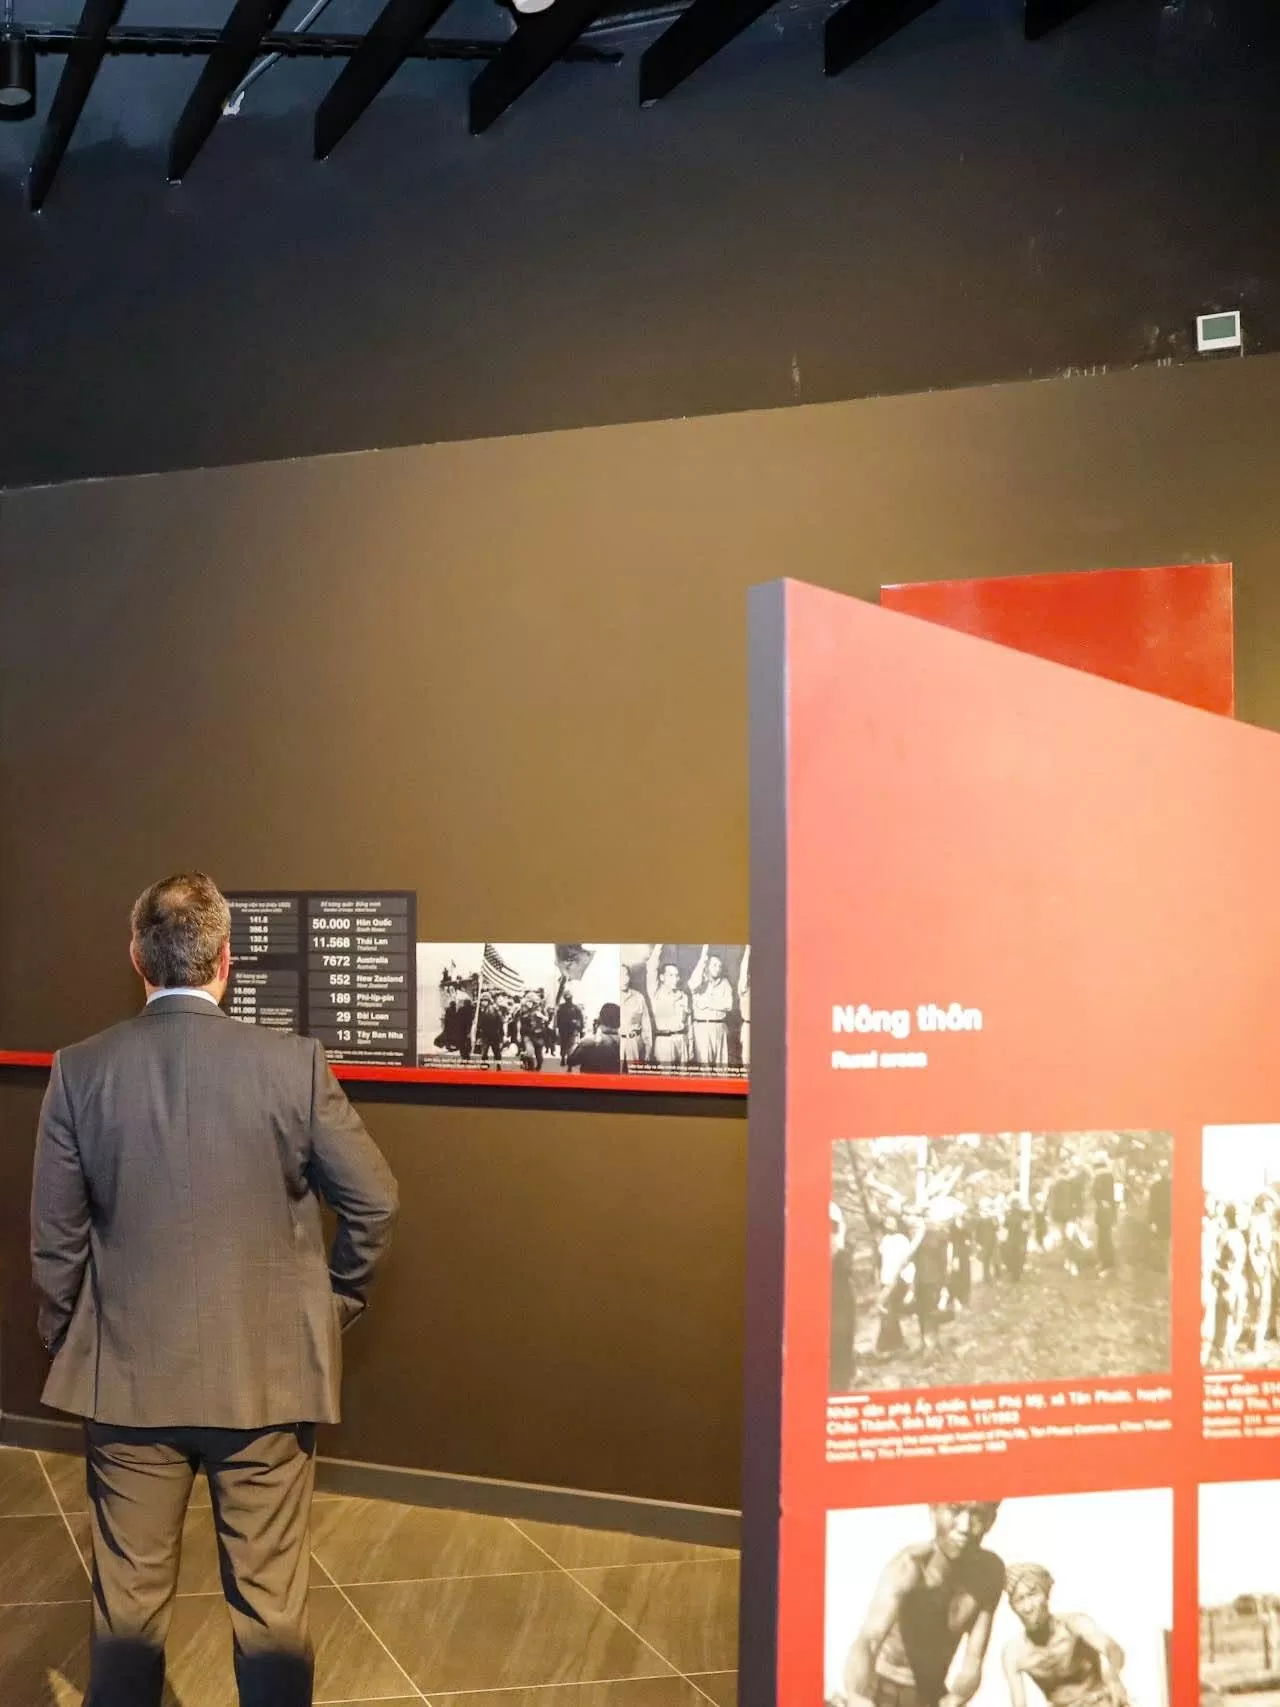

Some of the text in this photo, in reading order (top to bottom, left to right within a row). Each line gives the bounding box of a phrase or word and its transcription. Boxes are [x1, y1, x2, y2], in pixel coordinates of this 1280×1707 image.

[312, 918, 350, 929] 50.000
[313, 937, 350, 948] 11.568
[322, 955, 350, 967] 7672
[330, 974, 350, 985] 552
[330, 993, 350, 1004] 189
[336, 1011, 351, 1022] 29
[832, 1002, 983, 1039] Nông thôn
[337, 1030, 351, 1041] 13
